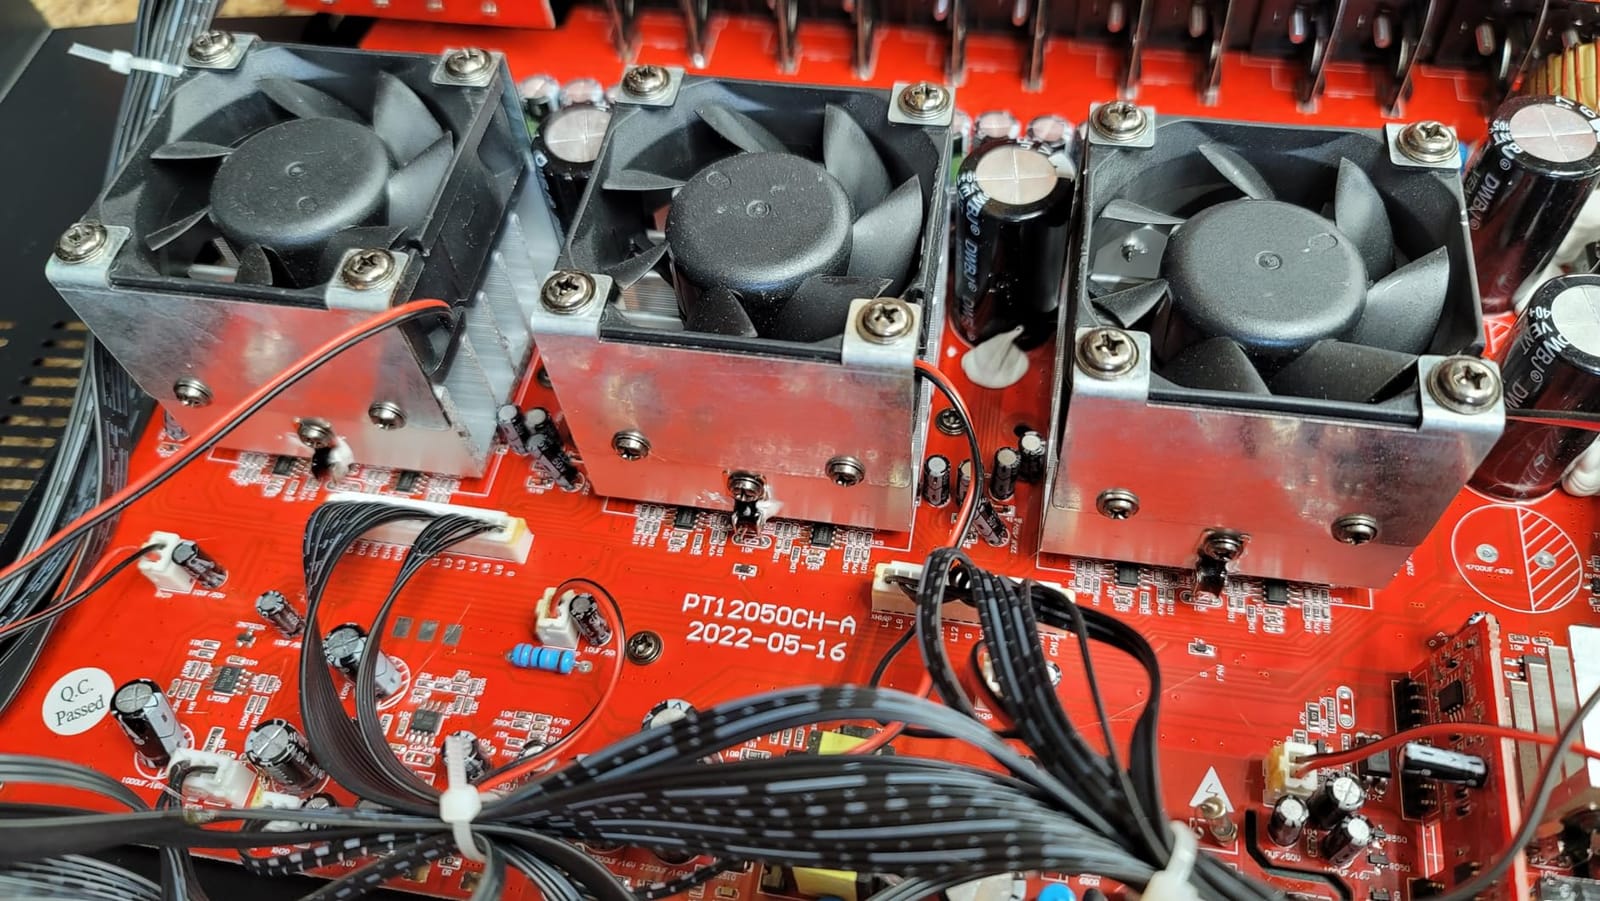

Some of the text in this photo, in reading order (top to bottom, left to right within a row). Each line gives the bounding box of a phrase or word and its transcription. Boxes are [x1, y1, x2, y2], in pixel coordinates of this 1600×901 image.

[682, 593, 856, 636] PT12050CH-A
[687, 621, 847, 662] 2022-05-16
[1216, 664, 1224, 682] FAN
[60, 679, 94, 702] Q.C.
[55, 695, 104, 726] Passed
